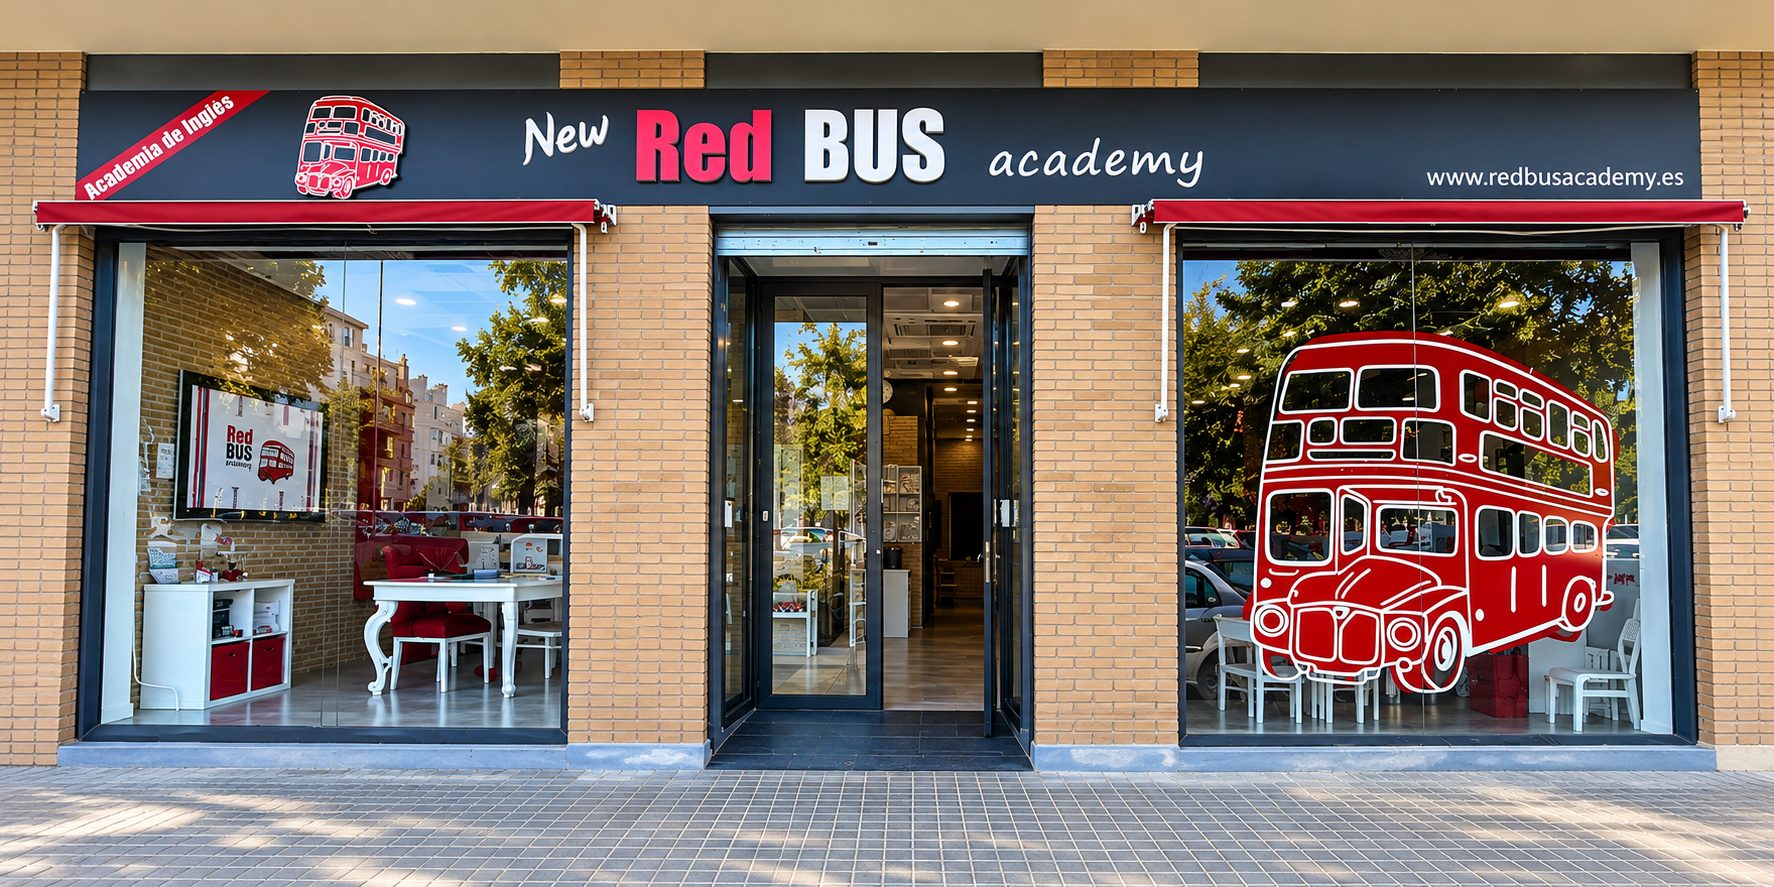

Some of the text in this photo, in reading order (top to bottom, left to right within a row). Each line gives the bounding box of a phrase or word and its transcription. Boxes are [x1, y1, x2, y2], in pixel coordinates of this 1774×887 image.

[522, 107, 1204, 188] New Red BUS academy
[83, 144, 164, 200] Academia
[161, 128, 185, 149] de
[1426, 166, 1685, 191] www.redbusacademy.es
[226, 424, 254, 445] Red
[226, 443, 253, 461] BUS
